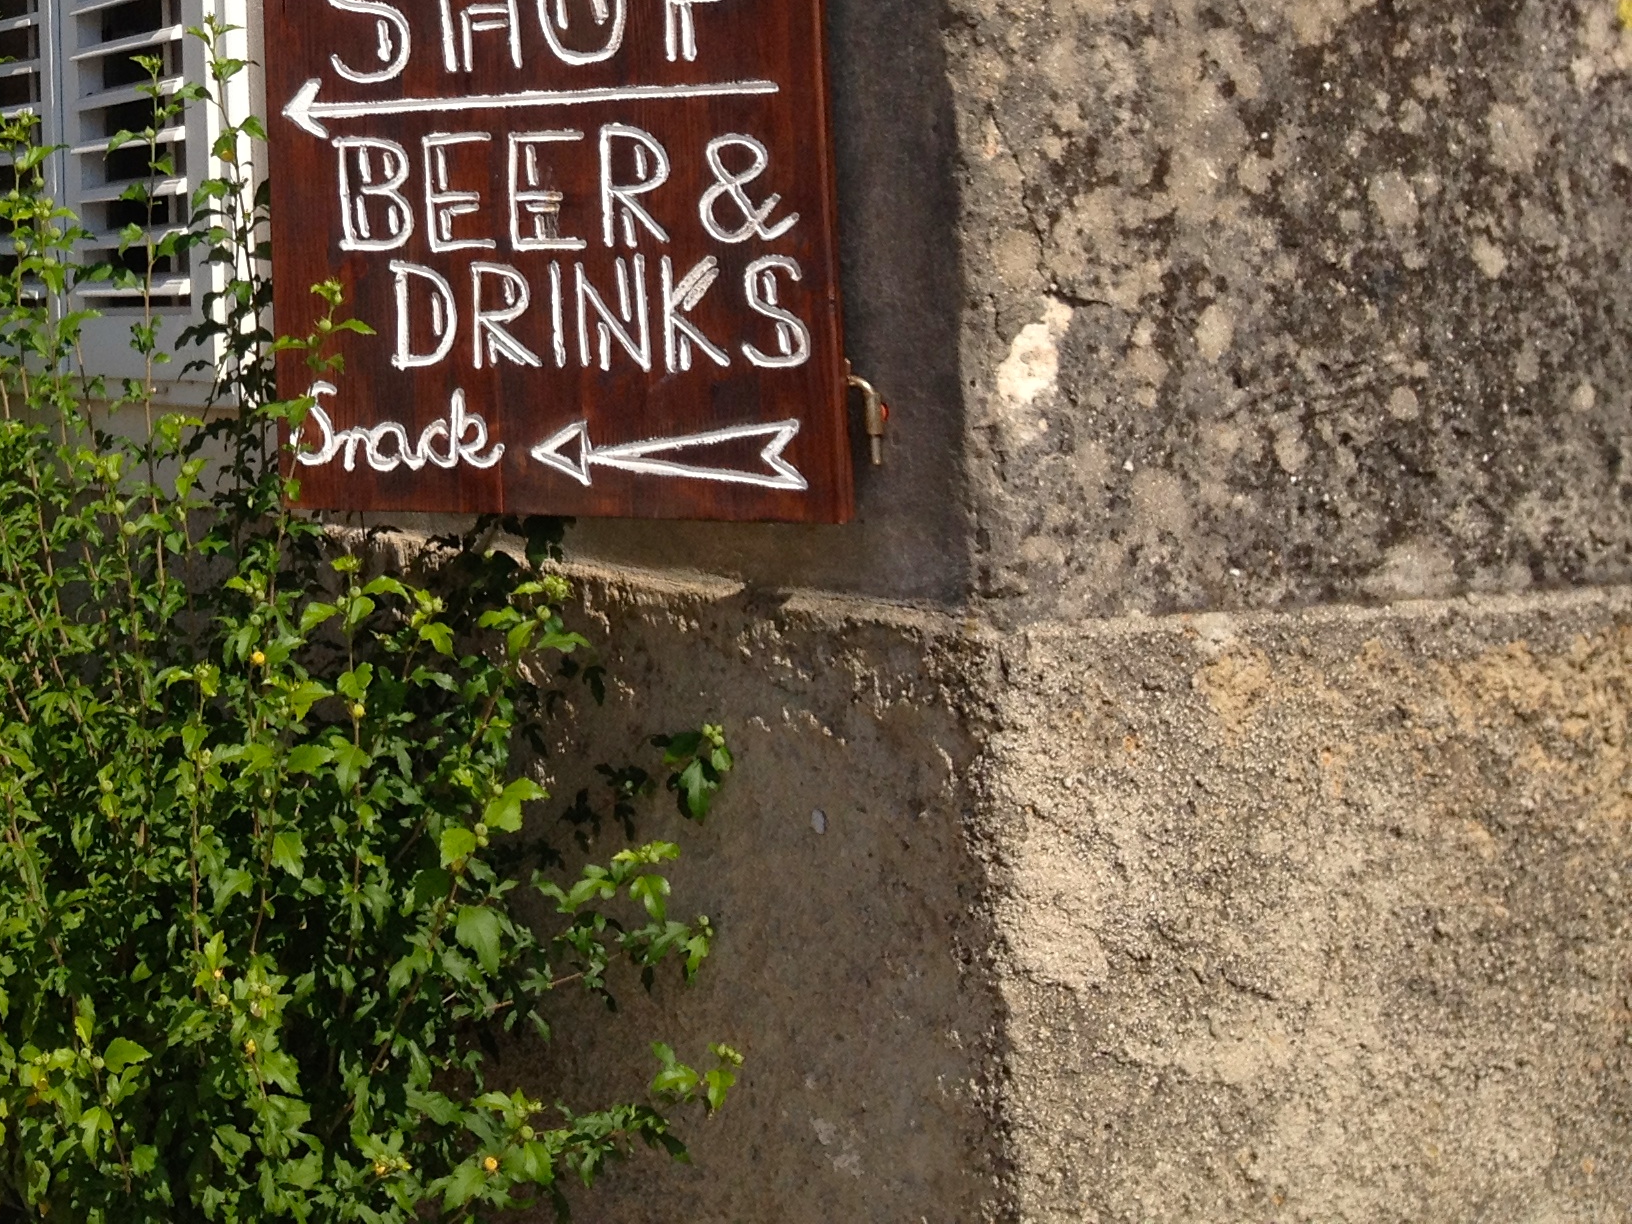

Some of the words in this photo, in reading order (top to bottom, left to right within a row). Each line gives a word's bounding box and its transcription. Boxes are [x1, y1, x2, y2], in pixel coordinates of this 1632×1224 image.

[330, 122, 672, 254] BEER
[698, 132, 800, 244] &
[388, 252, 811, 373] DRINKS
[288, 379, 506, 473] Snack
